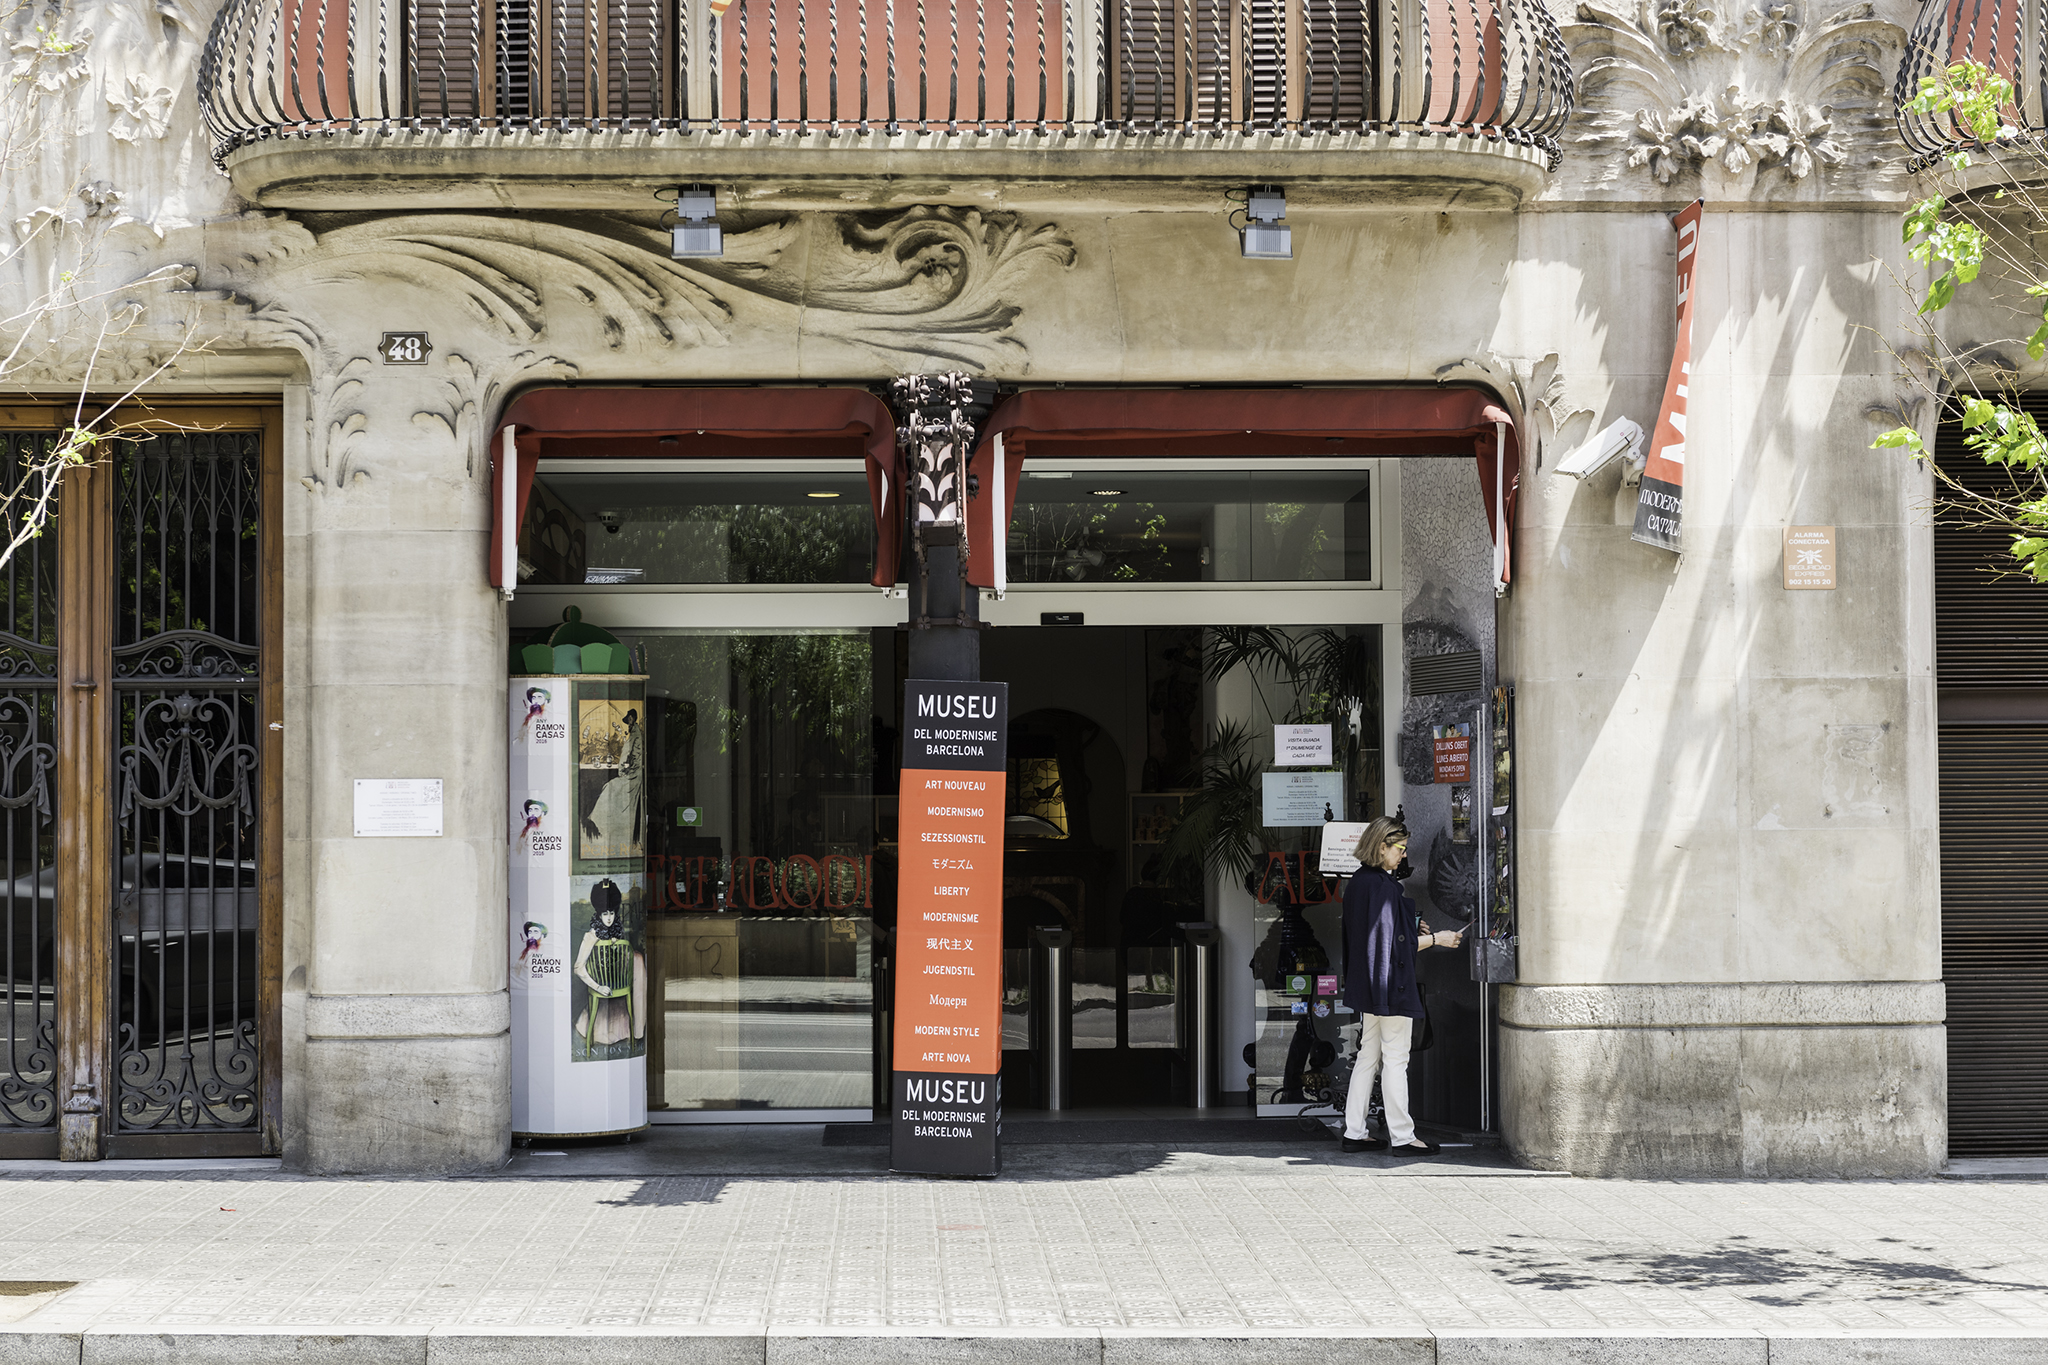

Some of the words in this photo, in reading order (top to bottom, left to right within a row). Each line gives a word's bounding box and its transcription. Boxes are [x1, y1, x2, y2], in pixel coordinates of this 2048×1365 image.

[388, 336, 422, 361] 48
[918, 694, 997, 719] MUSEU
[535, 731, 565, 739] CASAS
[914, 728, 932, 739] DEL
[935, 729, 998, 741] MODERNISME
[926, 744, 984, 756] BARCELONA
[925, 780, 942, 789] ART
[944, 781, 986, 791] NOUVEAU
[927, 806, 984, 817] MODERNISMO
[921, 832, 986, 844] SEZESSIONSTIL
[532, 843, 562, 851] CASAS
[932, 858, 974, 870] モダニズム
[934, 886, 970, 896] LIBERTY
[923, 912, 979, 923] MODERNISME
[926, 937, 974, 951] 现代主义
[531, 966, 561, 974] CASAS
[922, 965, 976, 976] JUGENDSTIL
[929, 993, 967, 1009] Модерн
[914, 1025, 951, 1036] MODERN
[952, 1027, 980, 1037] STYLE
[921, 1052, 945, 1062] ARTE
[946, 1053, 971, 1063] NOVA
[906, 1078, 985, 1105] MUSEU
[902, 1109, 920, 1120] DEL
[923, 1110, 986, 1123] MODERNISME
[914, 1125, 973, 1138] BARCELONA
